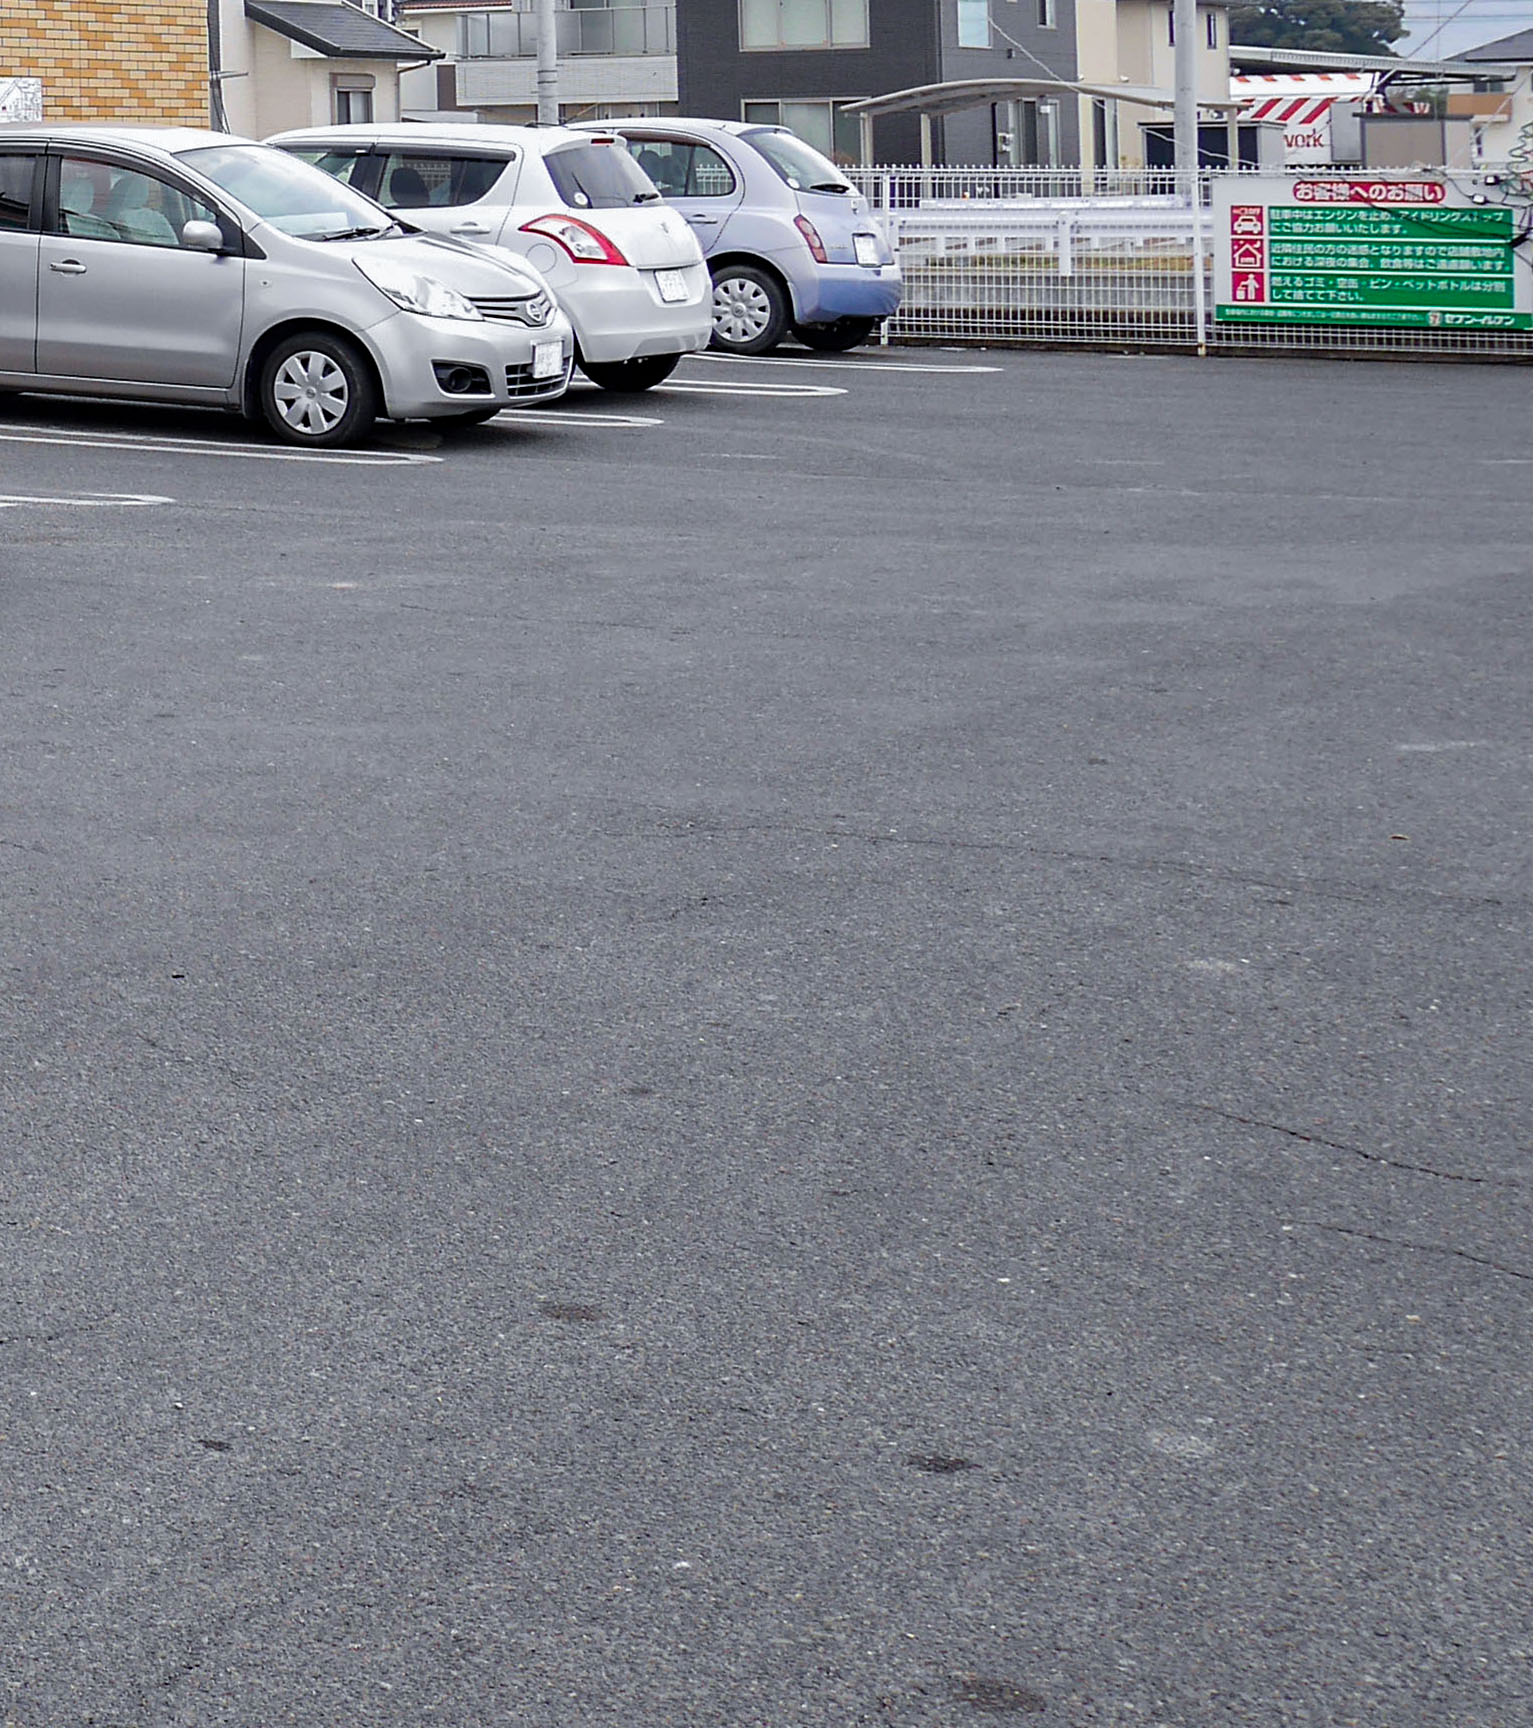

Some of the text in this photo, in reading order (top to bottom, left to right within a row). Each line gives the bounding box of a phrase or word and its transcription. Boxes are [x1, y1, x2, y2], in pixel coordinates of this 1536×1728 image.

[1294, 182, 1442, 202] お客様へのお願い
